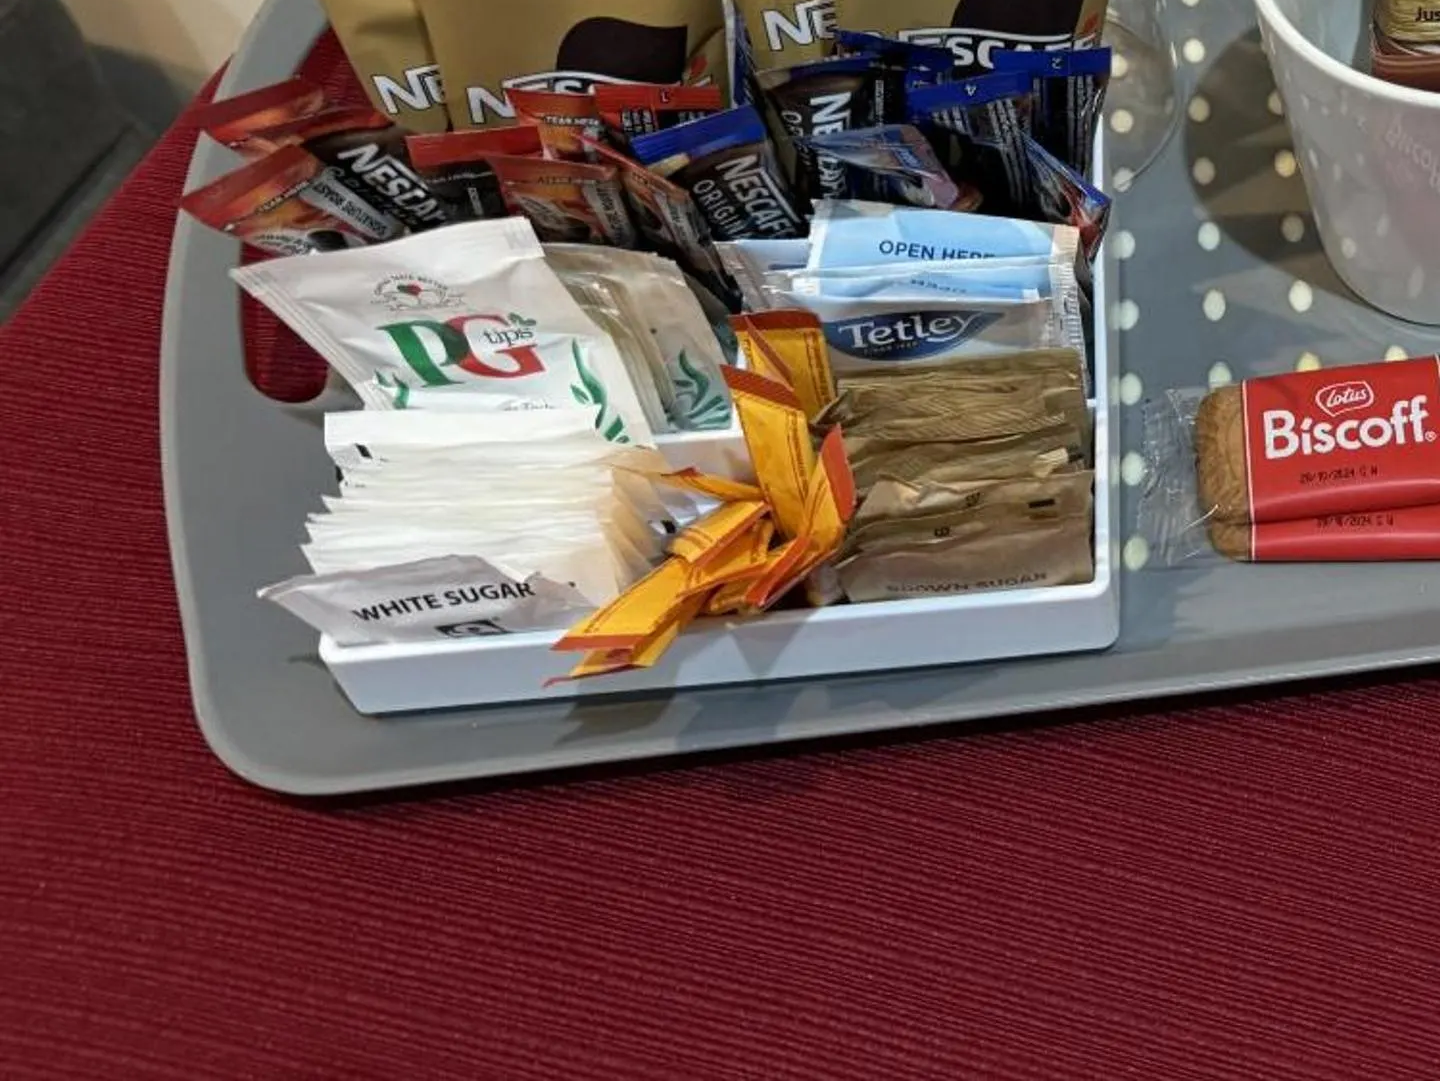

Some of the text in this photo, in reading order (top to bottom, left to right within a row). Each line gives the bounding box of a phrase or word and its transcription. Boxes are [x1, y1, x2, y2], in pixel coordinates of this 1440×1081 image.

[337, 142, 447, 223] NESCAF
[715, 153, 797, 239] NESCAF
[693, 178, 747, 239] ORIGIN
[879, 240, 996, 260] OPEN HER
[375, 313, 547, 388] PG
[483, 326, 534, 346] tips
[837, 310, 982, 351] Tetley
[1325, 387, 1368, 408] Lotus
[1263, 395, 1429, 460] Biscoff
[352, 582, 537, 622] WHITE SUGAR
